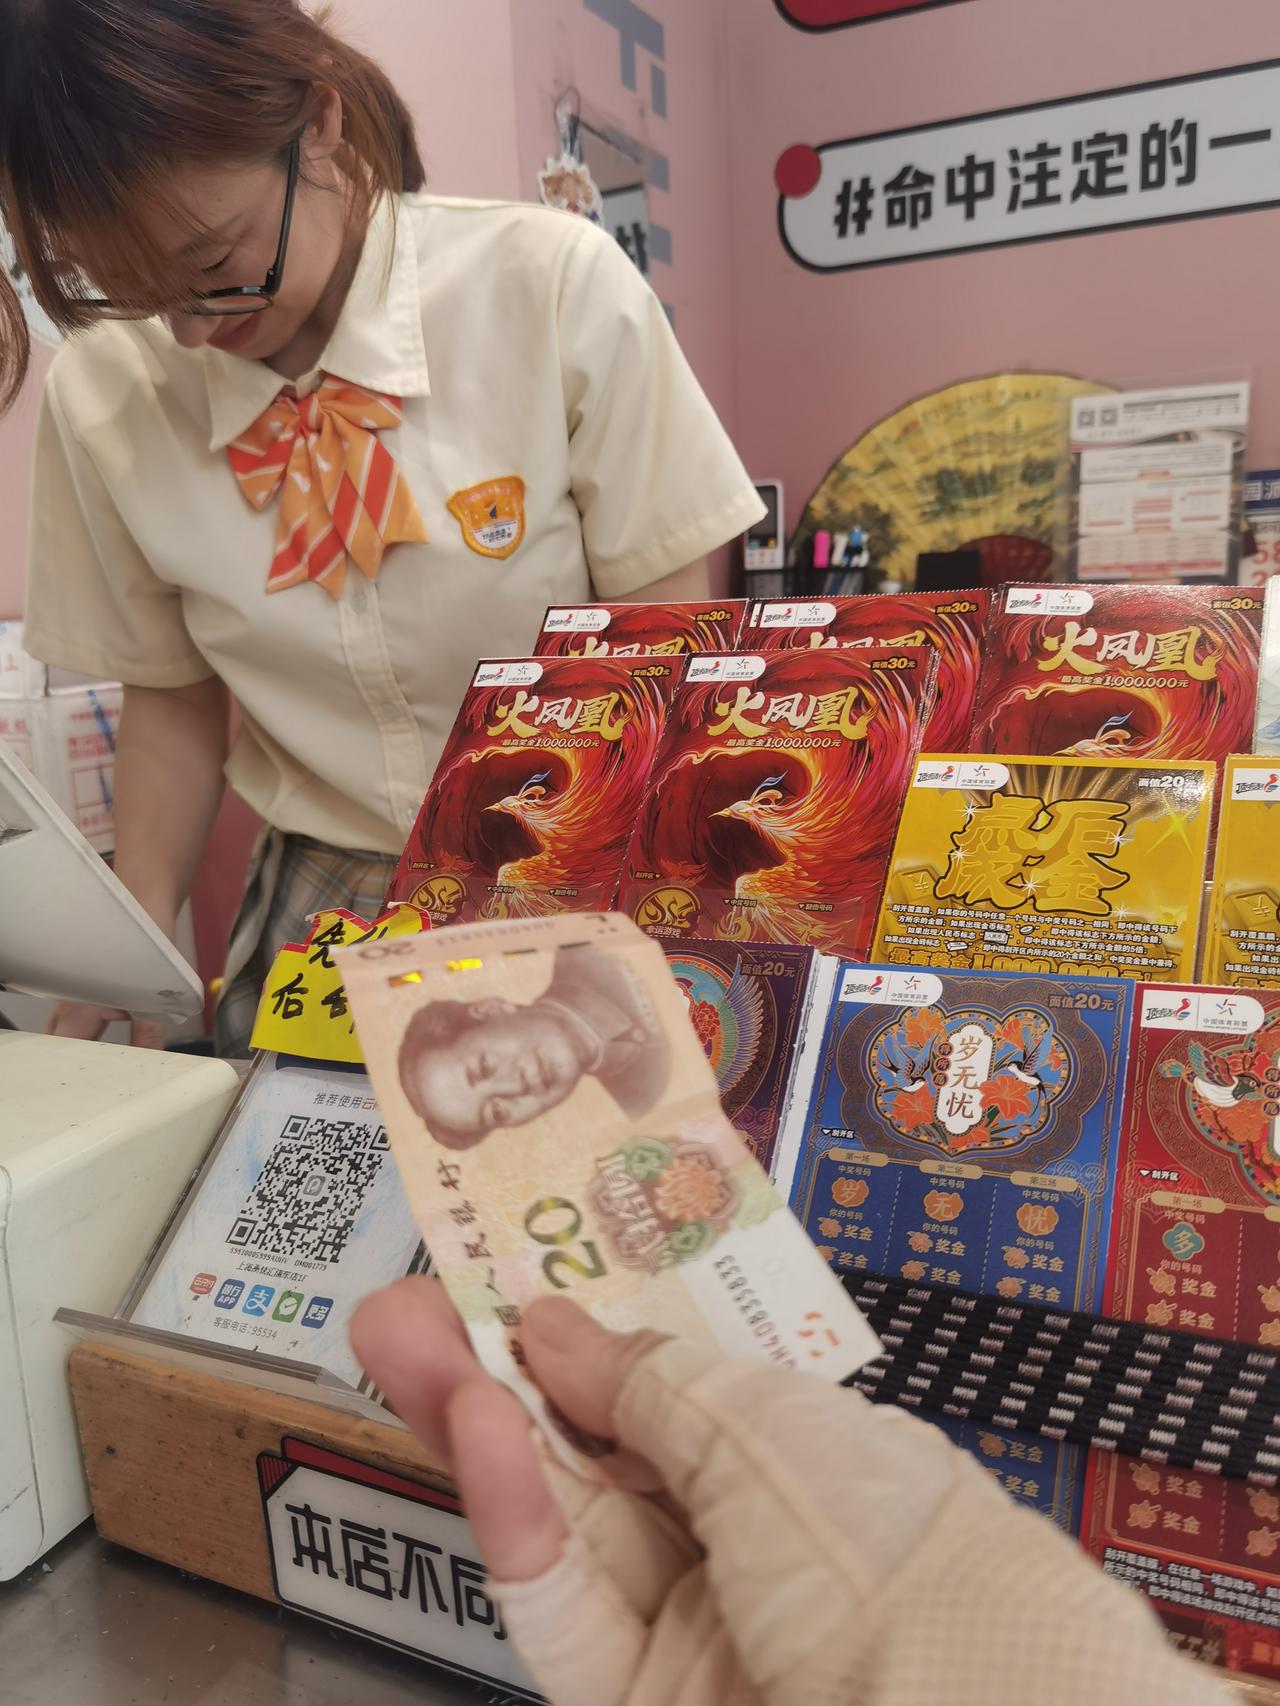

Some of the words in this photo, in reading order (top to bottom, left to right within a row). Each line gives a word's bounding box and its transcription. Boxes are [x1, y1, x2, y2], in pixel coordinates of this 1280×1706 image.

[1037, 621, 1224, 681] 火凤凰
[487, 691, 633, 741] 火凤凰
[707, 686, 879, 740] 火凤凰
[741, 961, 796, 977] 面值20元
[1049, 993, 1115, 1011] 面值20元
[313, 1092, 378, 1111] 推荐使用云
[844, 1224, 873, 1241] 奖金
[524, 1196, 607, 1290] 20
[935, 1238, 966, 1257] 奖金
[838, 1251, 869, 1269] 奖金
[1032, 1254, 1064, 1272] 奖金
[931, 1267, 961, 1286] 奖金
[222, 1284, 243, 1298] 银行
[1028, 1284, 1061, 1303] 奖金
[1181, 1278, 1217, 1298] 奖金
[217, 1295, 237, 1306] APP
[1179, 1309, 1215, 1330] 奖金
